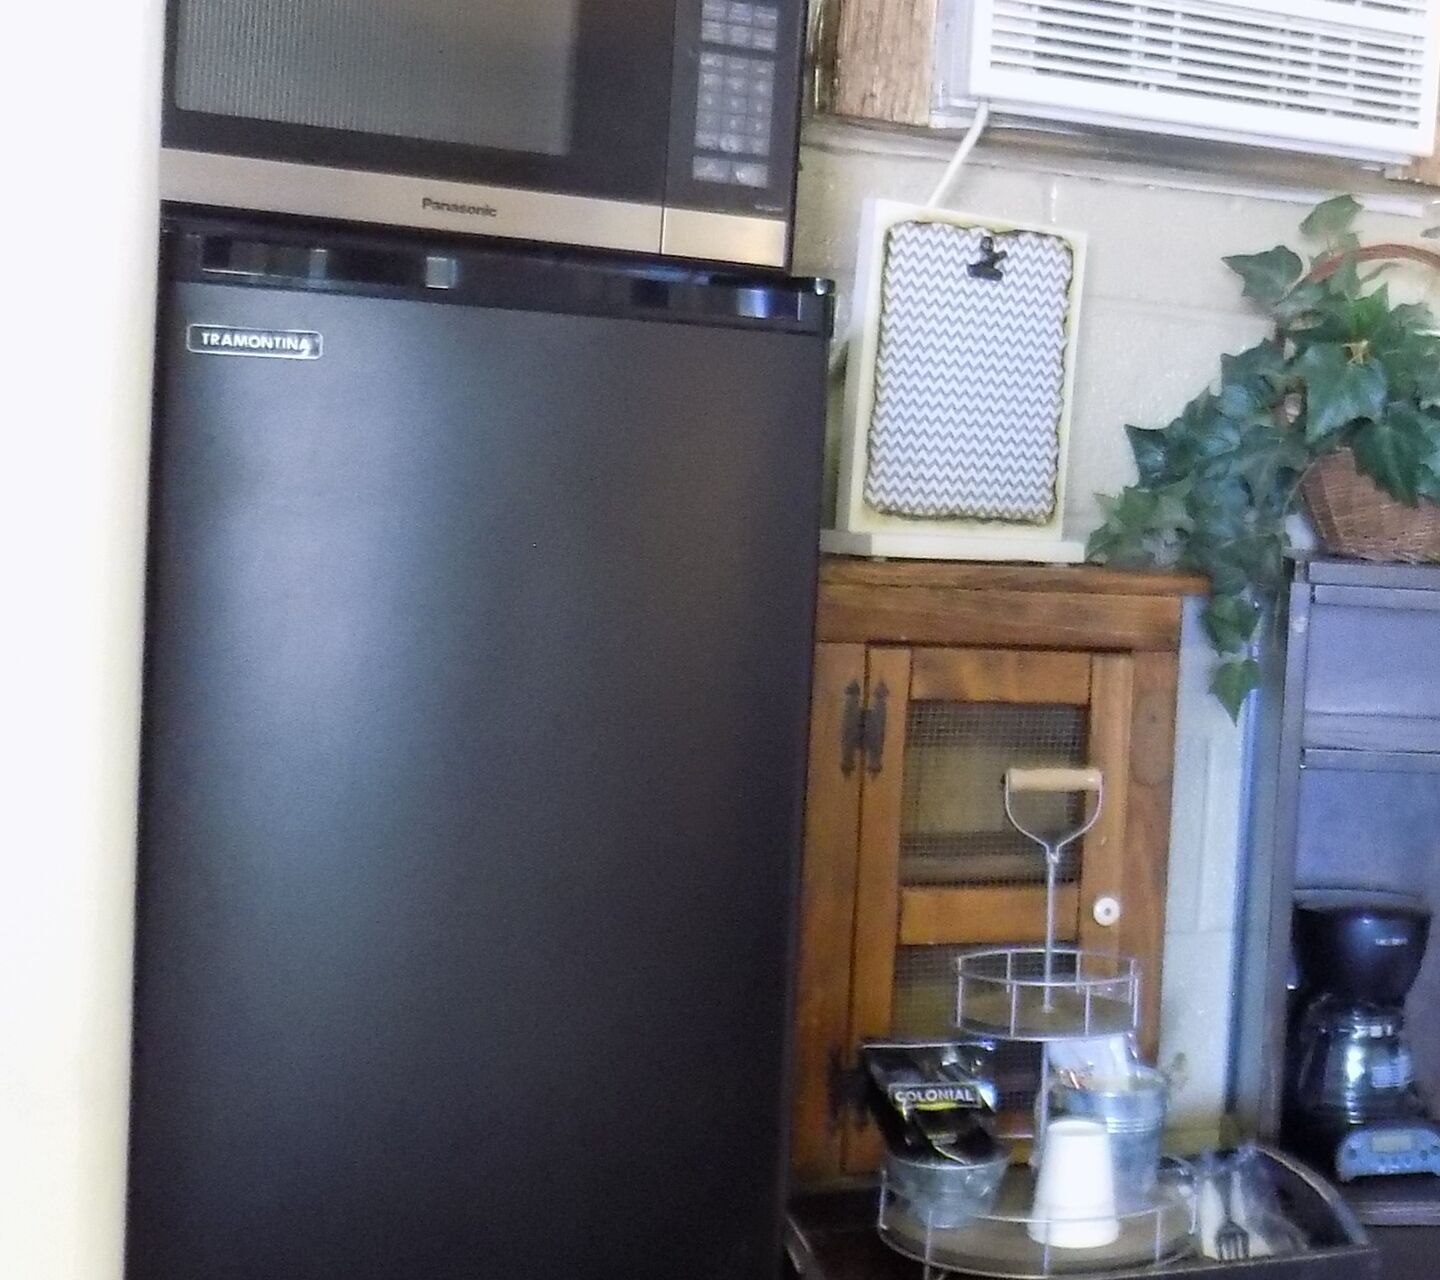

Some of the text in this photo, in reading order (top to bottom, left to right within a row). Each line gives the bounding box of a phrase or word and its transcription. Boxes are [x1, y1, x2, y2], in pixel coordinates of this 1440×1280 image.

[422, 197, 497, 217] Panasonic
[201, 332, 311, 351] TRAMONTINA
[895, 1088, 974, 1102] COLONIAL
